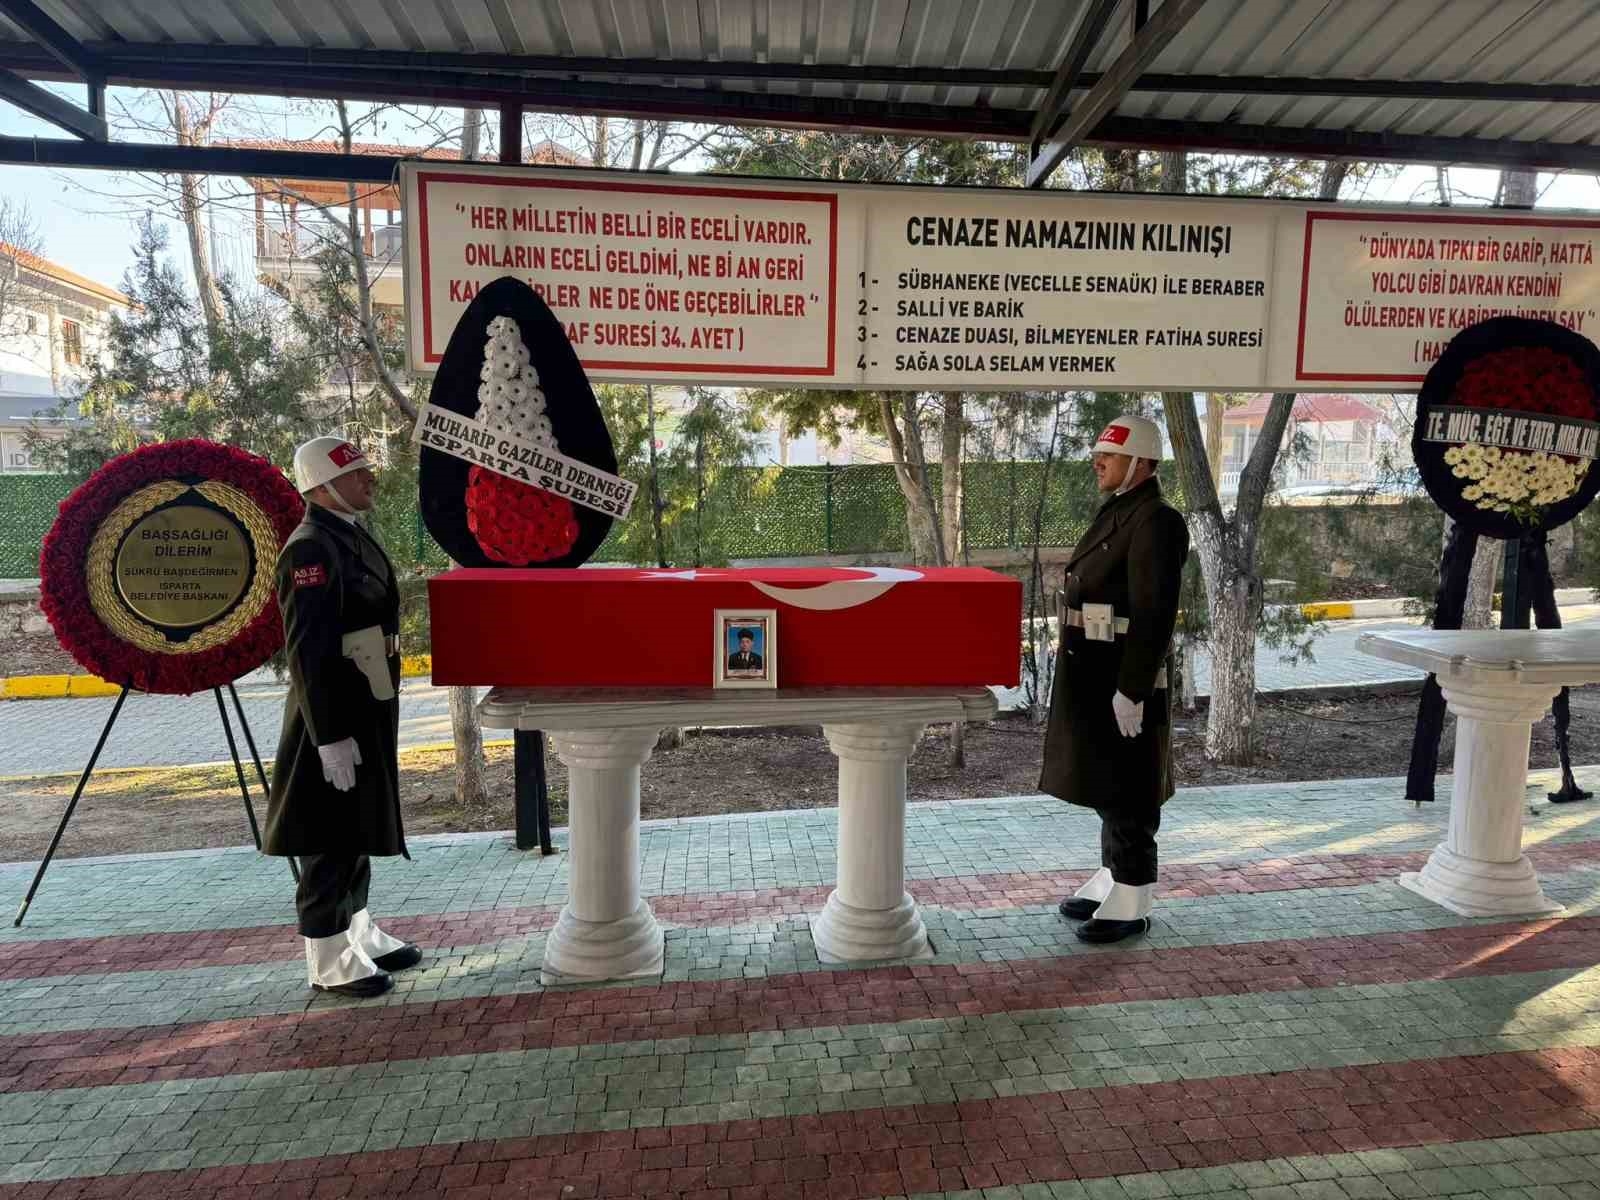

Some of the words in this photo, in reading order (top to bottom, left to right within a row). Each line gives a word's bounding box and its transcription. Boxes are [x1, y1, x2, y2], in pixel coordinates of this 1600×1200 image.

[471, 207, 507, 230] HER
[513, 205, 596, 235] MİLLETİN
[602, 210, 651, 237] BELLİ
[657, 212, 685, 239] BİR
[691, 215, 739, 242] ECELİ
[744, 221, 811, 245] VARDIR.
[906, 216, 998, 247] CENAZE
[1005, 219, 1135, 250] NAMAZININ
[1142, 223, 1231, 258] KILINIŞI
[465, 243, 546, 269] ONLARIN
[551, 244, 600, 271] ECELİ
[606, 248, 683, 280] GELDİMİ,
[689, 256, 709, 278] NE
[715, 251, 732, 278] Bİ
[737, 258, 760, 279] AN
[765, 254, 804, 281] GERİ
[1370, 232, 1434, 260] DÜNYADA
[1439, 239, 1472, 261] TIPKI
[1477, 237, 1499, 262] BİR
[1503, 237, 1546, 266] GARİP,
[898, 268, 1000, 291] SÜBHANEKE
[1004, 273, 1081, 293] (VECELLE
[1086, 273, 1157, 295] SENAÜK)
[1163, 275, 1187, 295] İLE
[1191, 278, 1265, 296] BERABER
[1371, 272, 1415, 293] YOLCU
[1419, 269, 1446, 295] GİBİ
[1450, 274, 1501, 296] DAVRAN
[1507, 271, 1561, 297] KENDİNİ
[589, 289, 612, 309] NE
[618, 290, 640, 311] DE
[645, 283, 679, 312] ÖNE
[684, 288, 805, 317] GEÇEBİLİRLER
[897, 297, 944, 316] SALLİ
[949, 301, 968, 317] VE
[974, 299, 1024, 318] BARİK
[1345, 300, 1425, 327] ÖLÜLERDEN
[1429, 308, 1445, 328] VE
[594, 321, 656, 349] SURESİ
[662, 325, 686, 348] 34.
[690, 327, 733, 350] AYET
[896, 327, 960, 344] CENAZE
[965, 328, 1019, 347] DUASI,
[1025, 324, 1138, 346] BİLMEYENLER
[1145, 325, 1201, 346] FATİHA
[1207, 327, 1263, 347] SURESİ
[896, 350, 939, 371] SAĞA
[943, 356, 985, 371] SOLA
[990, 356, 1044, 372] SELAM
[1049, 357, 1116, 373] VERMEK
[424, 411, 495, 449] MUHARİP
[498, 441, 563, 477] GAZİLER
[567, 467, 632, 504] DERNEĞİ
[421, 431, 530, 481] ISPARTA
[539, 475, 625, 516] ŞUBESİ
[142, 529, 228, 542] BAŞSAĞLIĞI
[155, 545, 212, 557] DİLERİM
